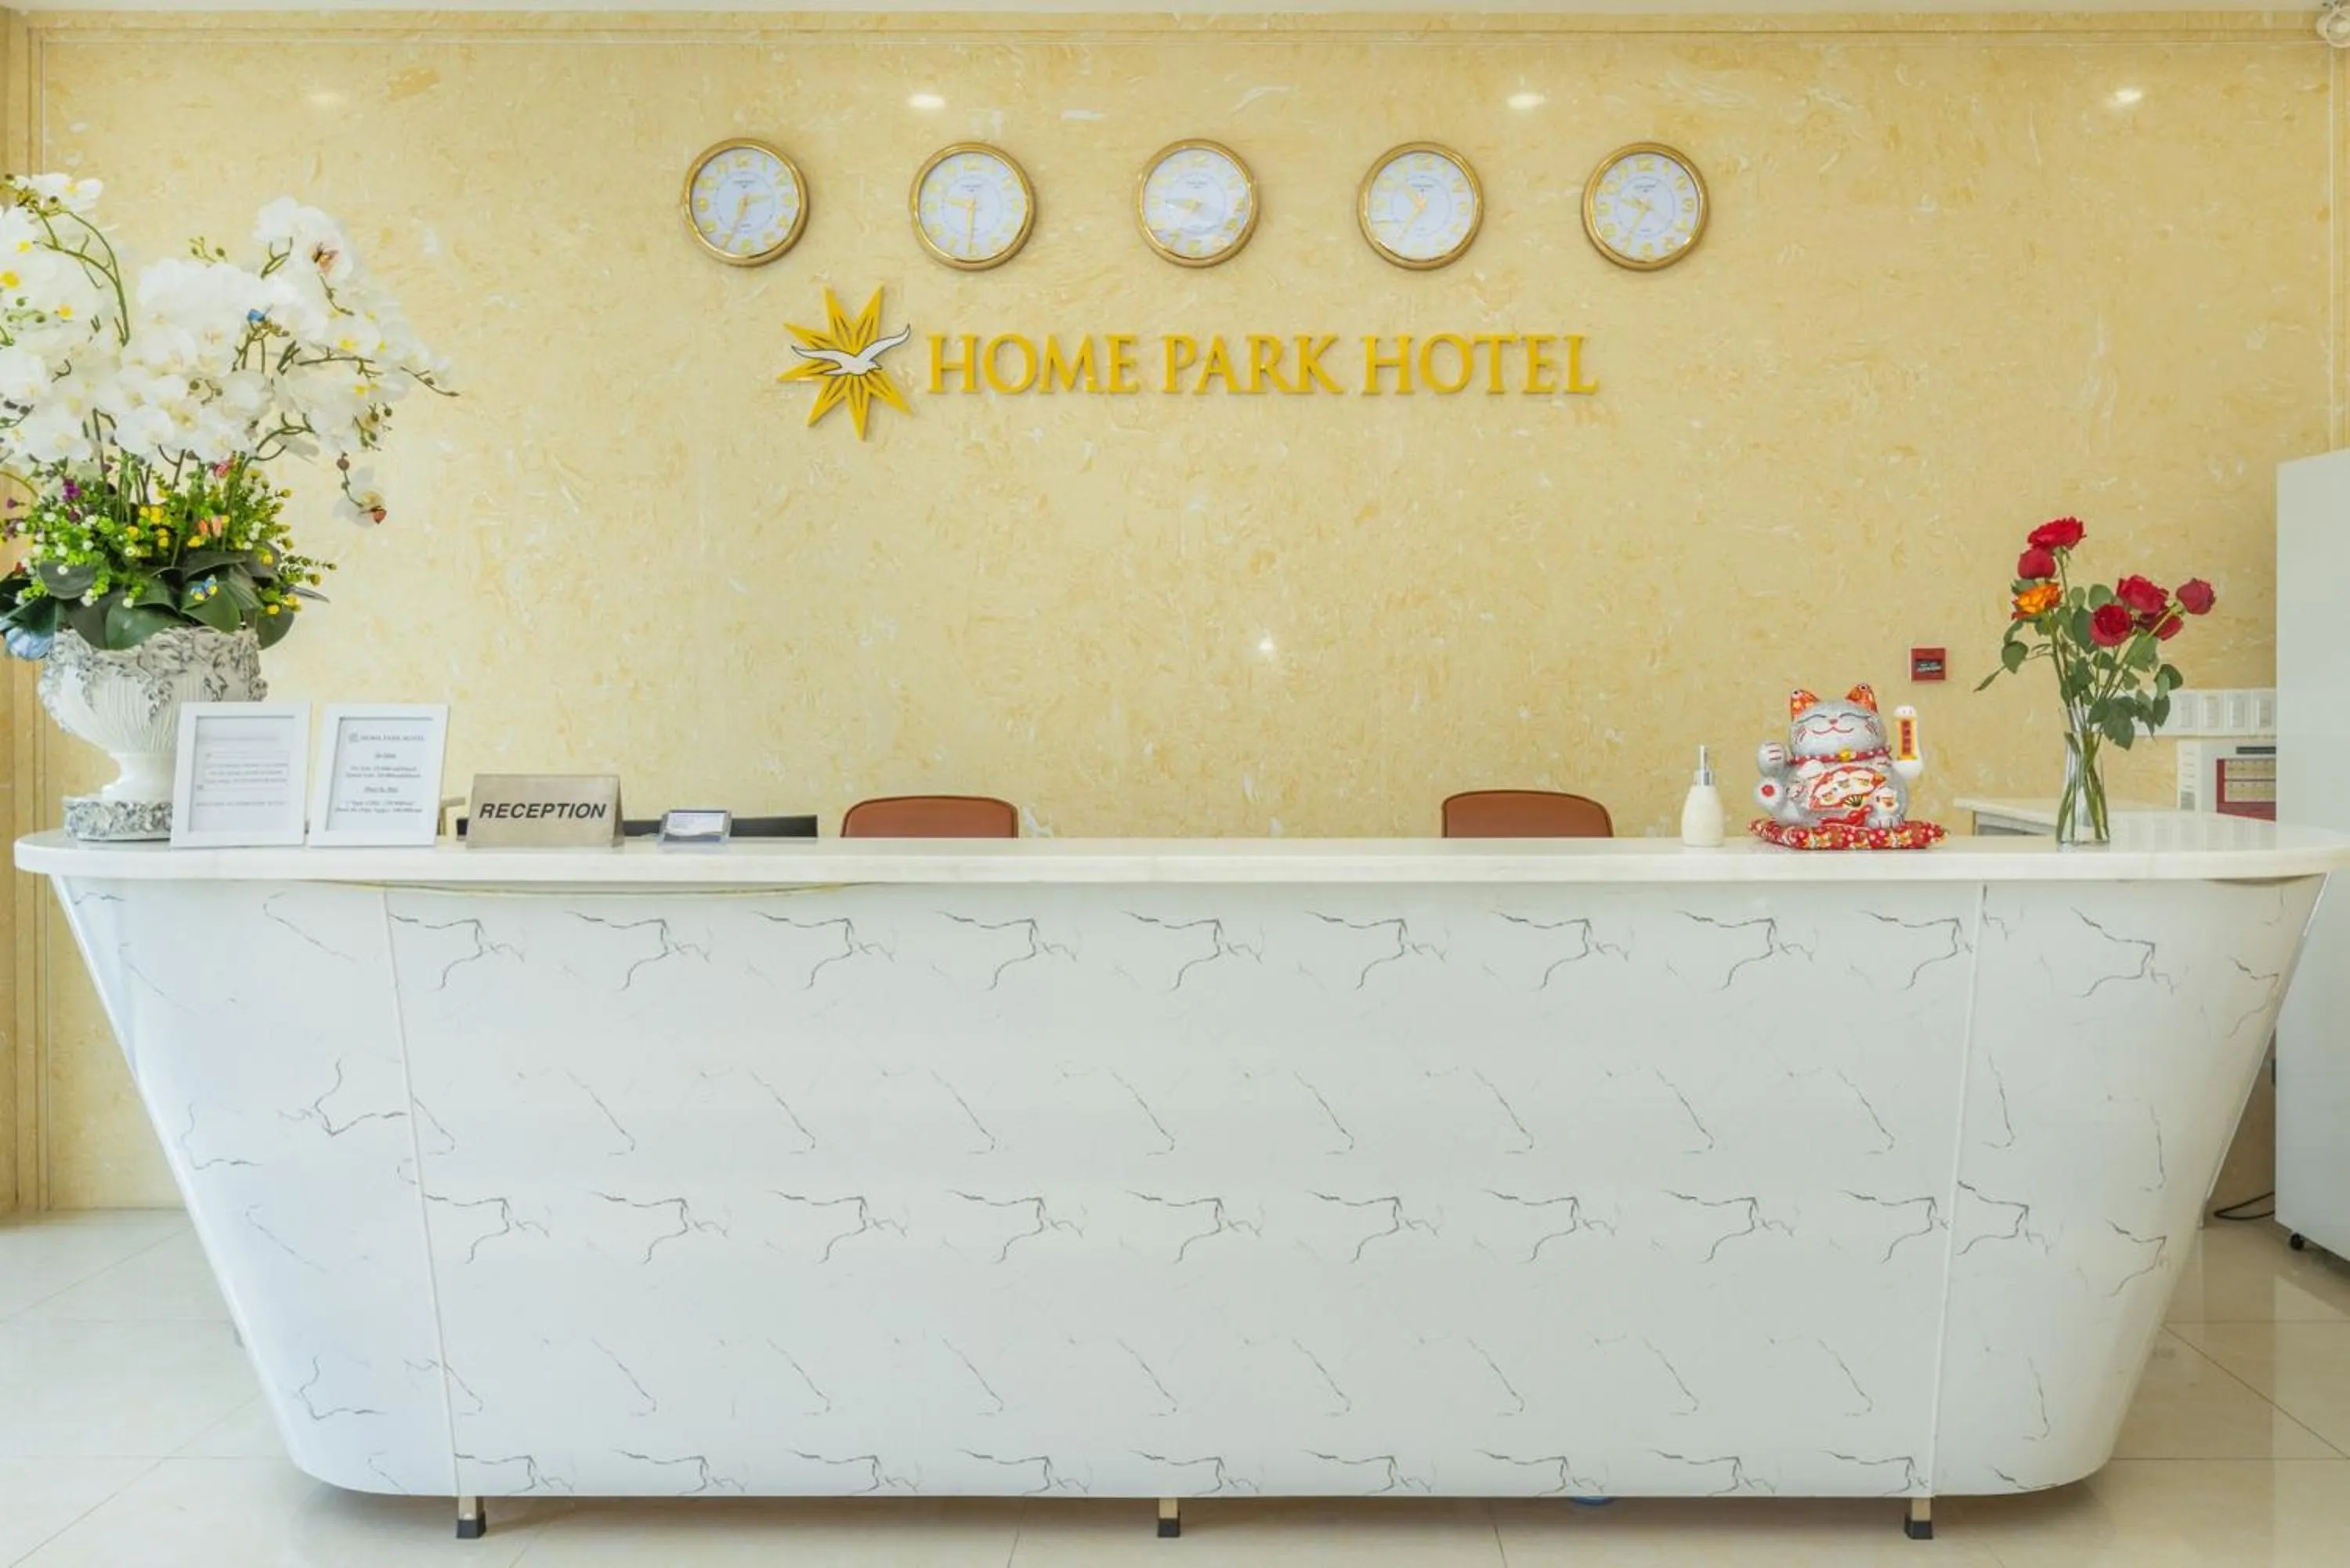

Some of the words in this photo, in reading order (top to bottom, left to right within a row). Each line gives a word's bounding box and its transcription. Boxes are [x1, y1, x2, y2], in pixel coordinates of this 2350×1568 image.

[927, 333, 1141, 396] HOME
[1162, 334, 1344, 396] PARK
[1361, 333, 1600, 396] HOTEL
[479, 802, 607, 819] RECEPTION
